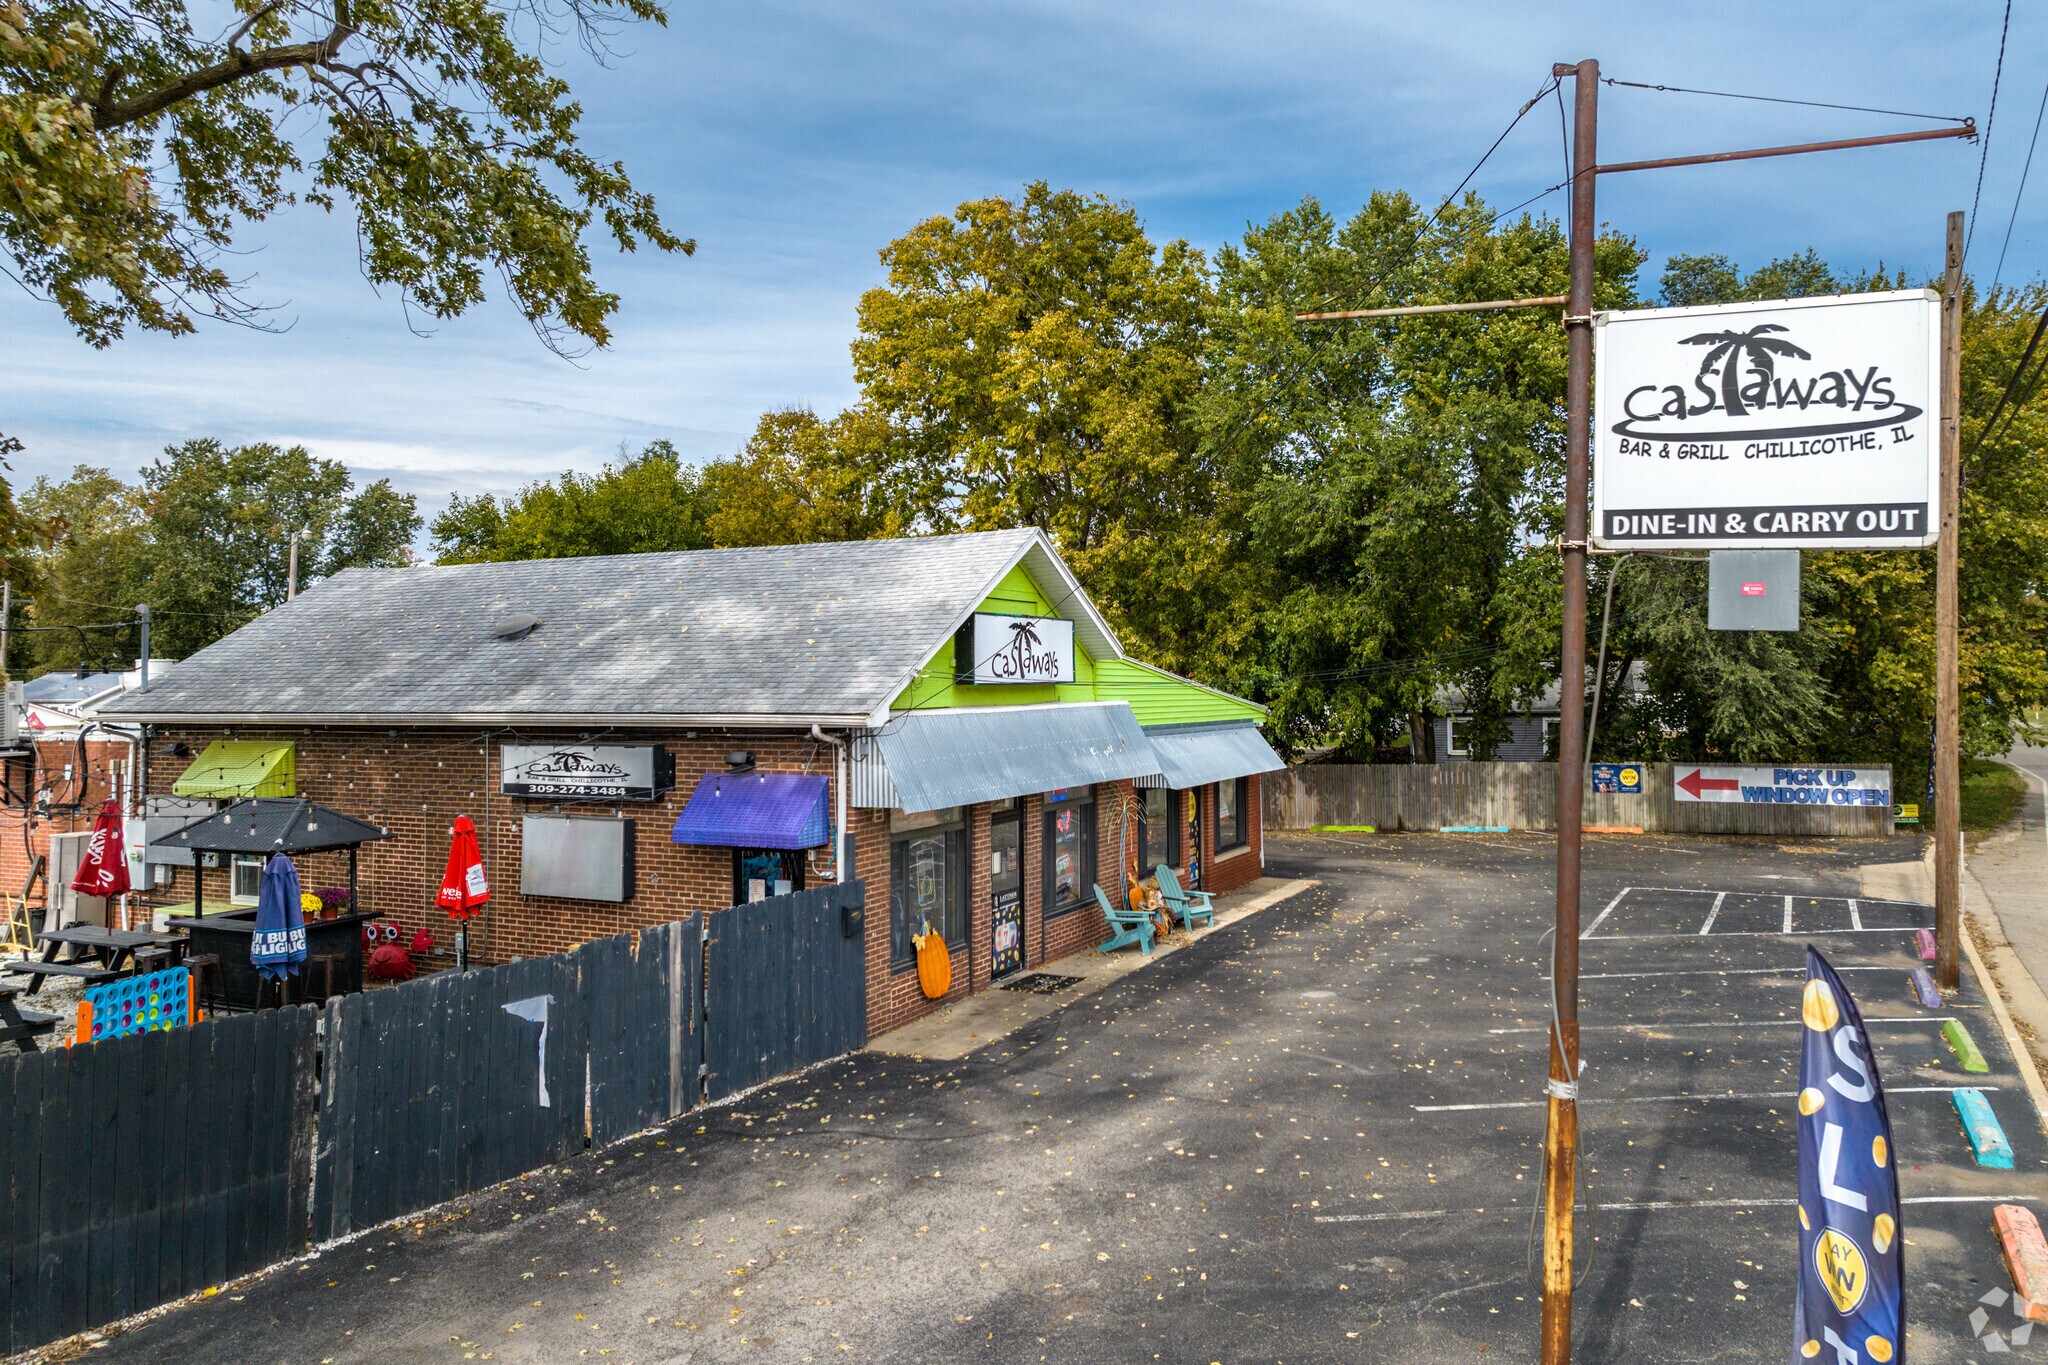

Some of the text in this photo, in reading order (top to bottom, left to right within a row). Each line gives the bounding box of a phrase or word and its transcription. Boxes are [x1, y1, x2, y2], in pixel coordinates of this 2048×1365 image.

[1619, 425, 1914, 461] BAR & GRILL CHILLICOTHE, IL
[1612, 508, 1920, 536] DINE-IN & CARRY OUT
[1773, 768, 1856, 787] PICK UP
[528, 784, 627, 796] 309-274-3484
[1741, 786, 1890, 806] WINDOW OPEN
